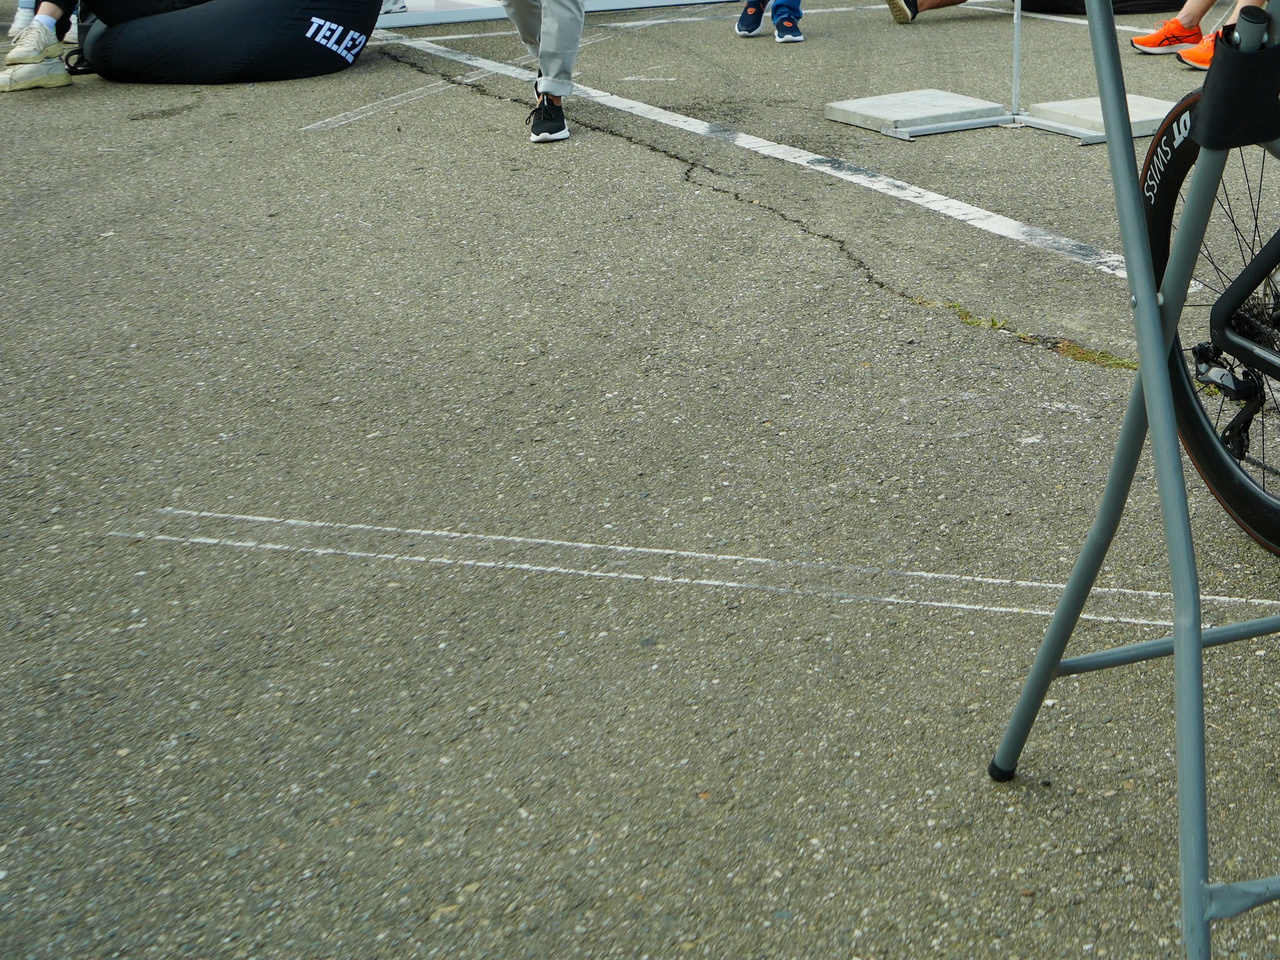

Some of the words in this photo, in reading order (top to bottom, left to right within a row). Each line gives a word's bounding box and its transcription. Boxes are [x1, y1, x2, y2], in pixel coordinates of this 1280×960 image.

[305, 16, 367, 64] TELE2
[1172, 110, 1191, 149] DT
[1144, 135, 1172, 205] SWISS
